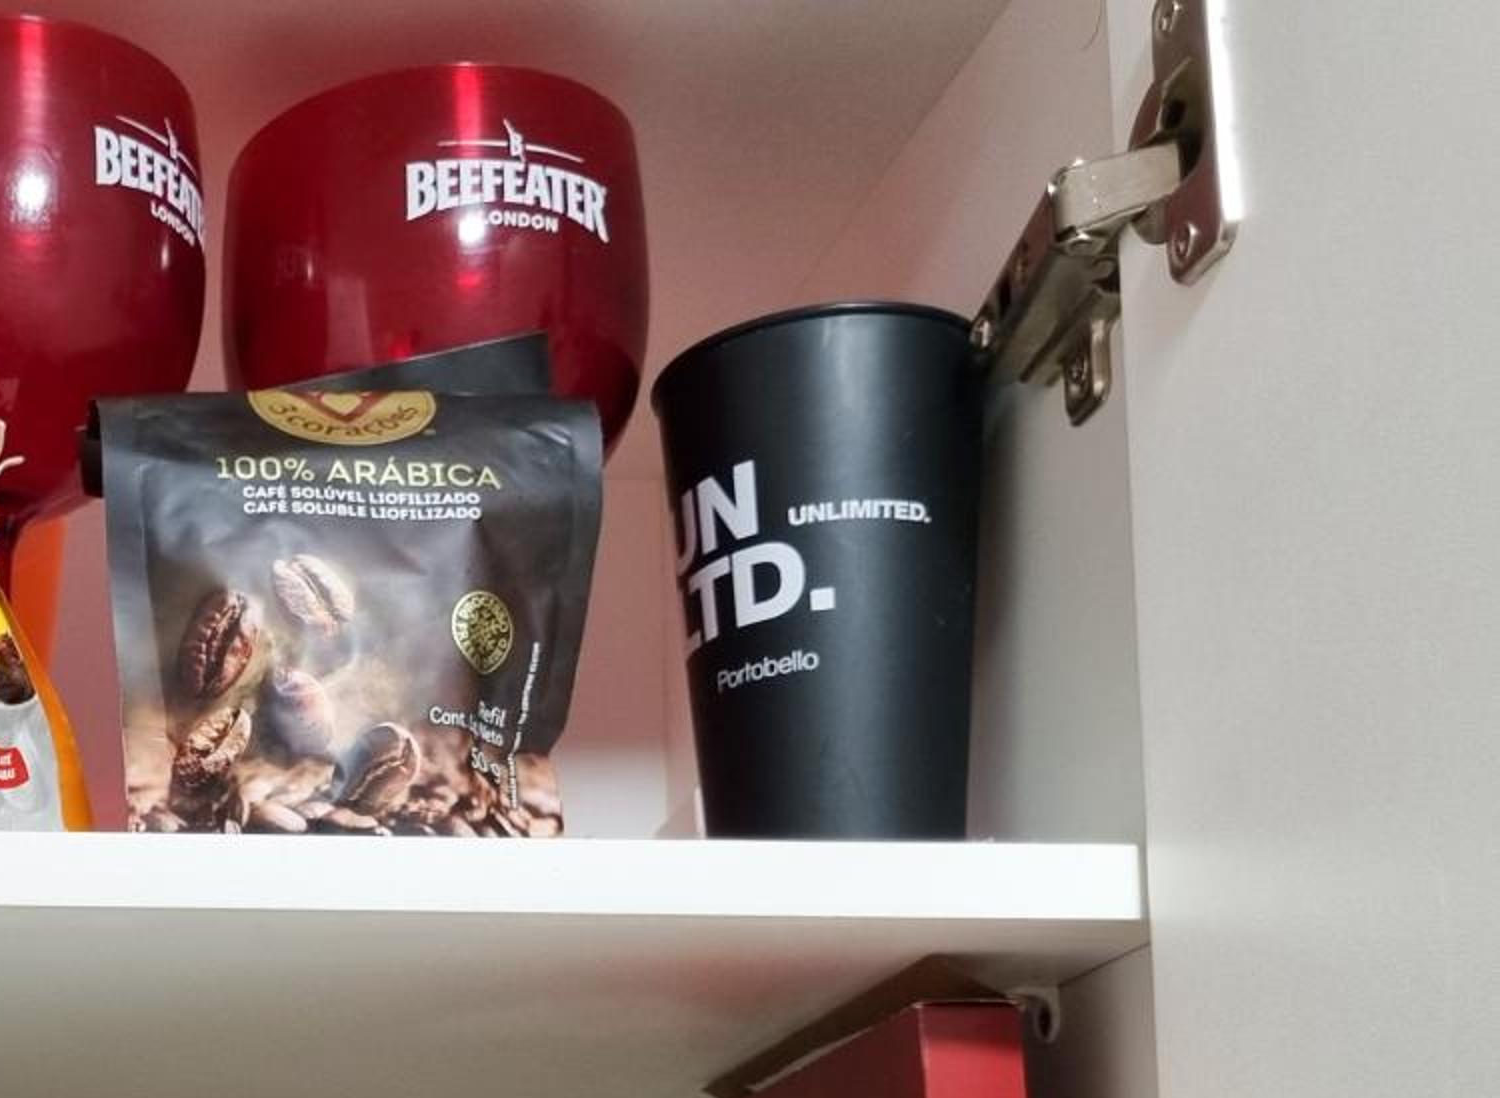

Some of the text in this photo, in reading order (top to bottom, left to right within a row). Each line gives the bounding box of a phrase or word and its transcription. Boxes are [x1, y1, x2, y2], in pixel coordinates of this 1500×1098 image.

[406, 159, 610, 244] BEEFEATER
[482, 208, 560, 234] LONDON
[216, 456, 502, 491] 100% ARÁBICA
[243, 484, 480, 505] CAFÉ SOLÚVEL LIOFILIZADO
[243, 500, 483, 521] CAFÉ SOLUBLE LIOFILIZADO
[787, 498, 932, 527] UNLIMITED.
[717, 650, 820, 693] Portobello
